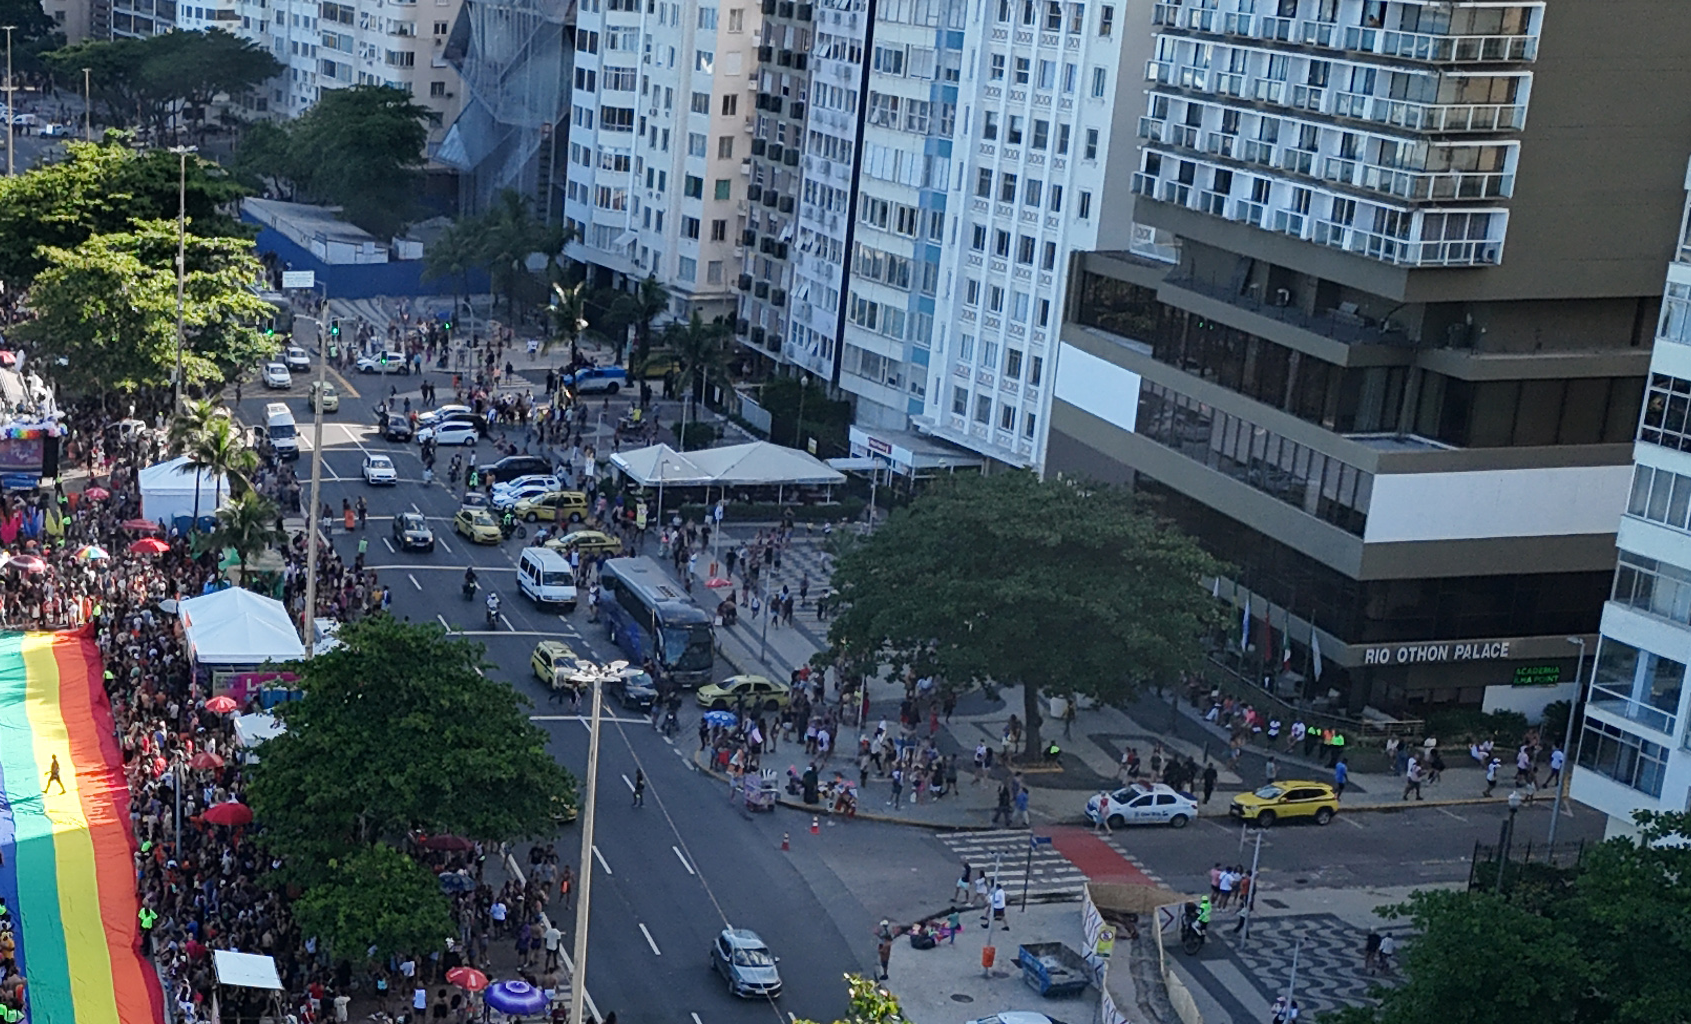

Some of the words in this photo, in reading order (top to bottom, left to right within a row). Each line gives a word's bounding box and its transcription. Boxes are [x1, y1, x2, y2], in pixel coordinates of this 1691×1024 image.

[1365, 649, 1390, 664] RIO
[1397, 645, 1449, 663] OTHON
[1454, 642, 1510, 660] PALACE
